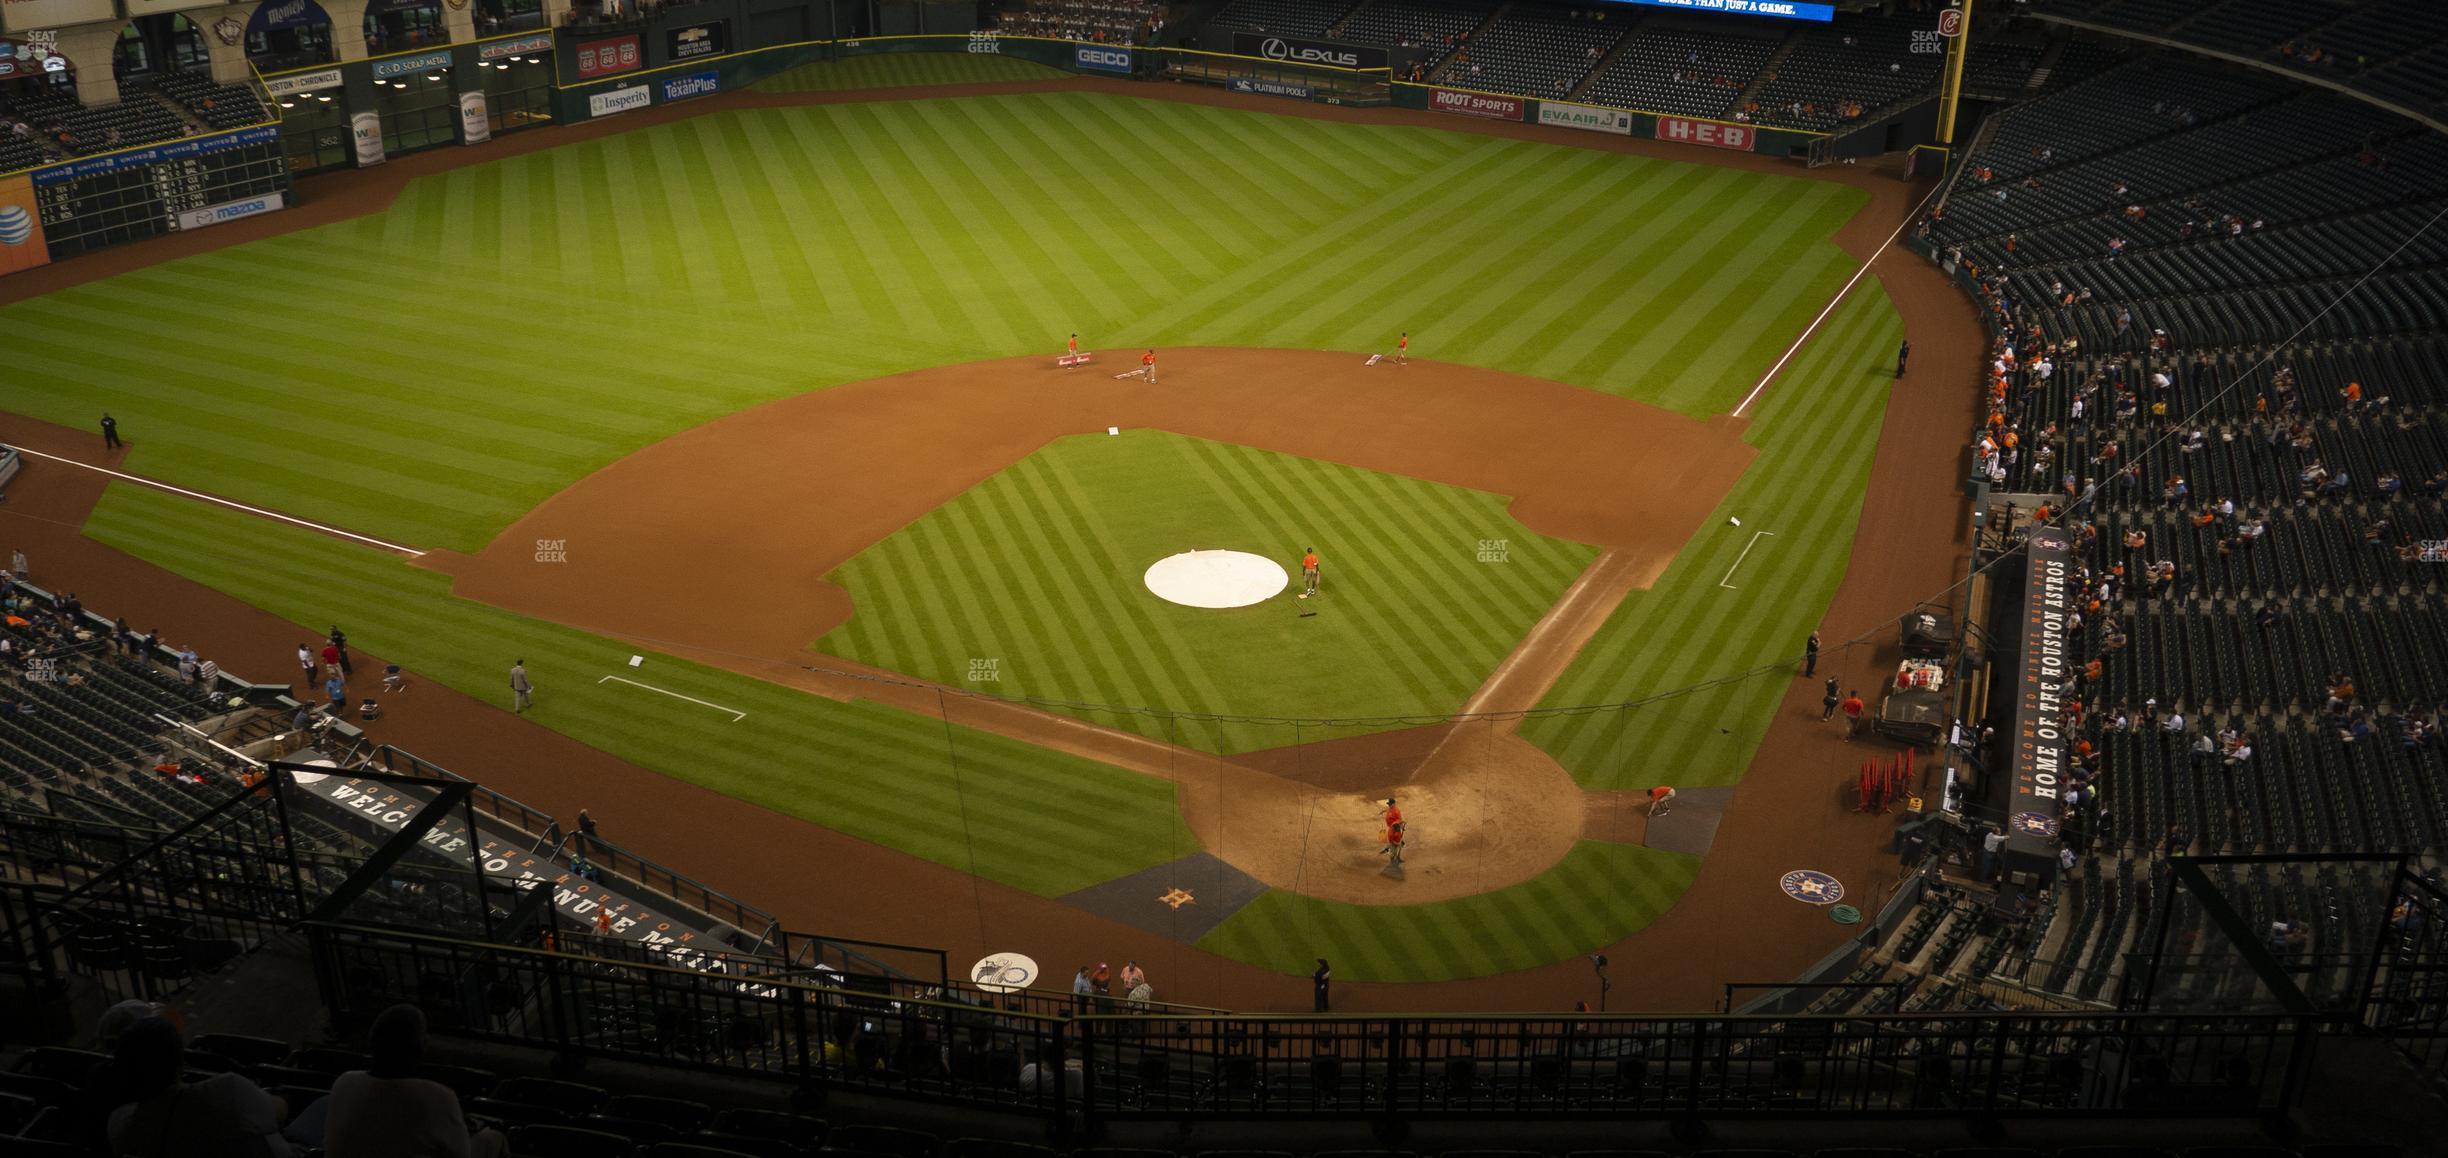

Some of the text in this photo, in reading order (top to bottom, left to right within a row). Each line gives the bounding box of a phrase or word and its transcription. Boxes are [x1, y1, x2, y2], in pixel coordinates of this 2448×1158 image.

[1725, 0, 1748, 10] JUST
[1749, 2, 1757, 11] A
[1759, 3, 1796, 15] GAME.
[402, 60, 425, 72] SCRAP
[426, 55, 447, 67] METAL
[1078, 49, 1128, 67] GEICO
[1290, 47, 1358, 66] LEXUS
[301, 72, 338, 87] CHRONICLE
[665, 79, 717, 98] TexanPlus
[1254, 82, 1307, 97] PLATINUM POOLS
[605, 91, 648, 109] Insperity
[1436, 91, 1472, 107] ROOT
[1472, 98, 1515, 112] SPORTS
[1542, 109, 1599, 126] EVA AIR
[202, 138, 230, 149] UNITED
[242, 130, 269, 141] UNITED
[120, 152, 149, 164] UNITED
[162, 145, 191, 156] UNITED
[36, 169, 65, 181] UNITED
[77, 160, 106, 172] UNITED
[217, 200, 265, 219] mazda
[2044, 560, 2065, 608] ASTROS
[2041, 610, 2063, 677] HOUSTON
[2039, 681, 2062, 712] THE
[2037, 716, 2060, 740] OF
[2034, 745, 2059, 800] HOME
[330, 784, 467, 852] WELCME
[484, 840, 536, 868] THE
